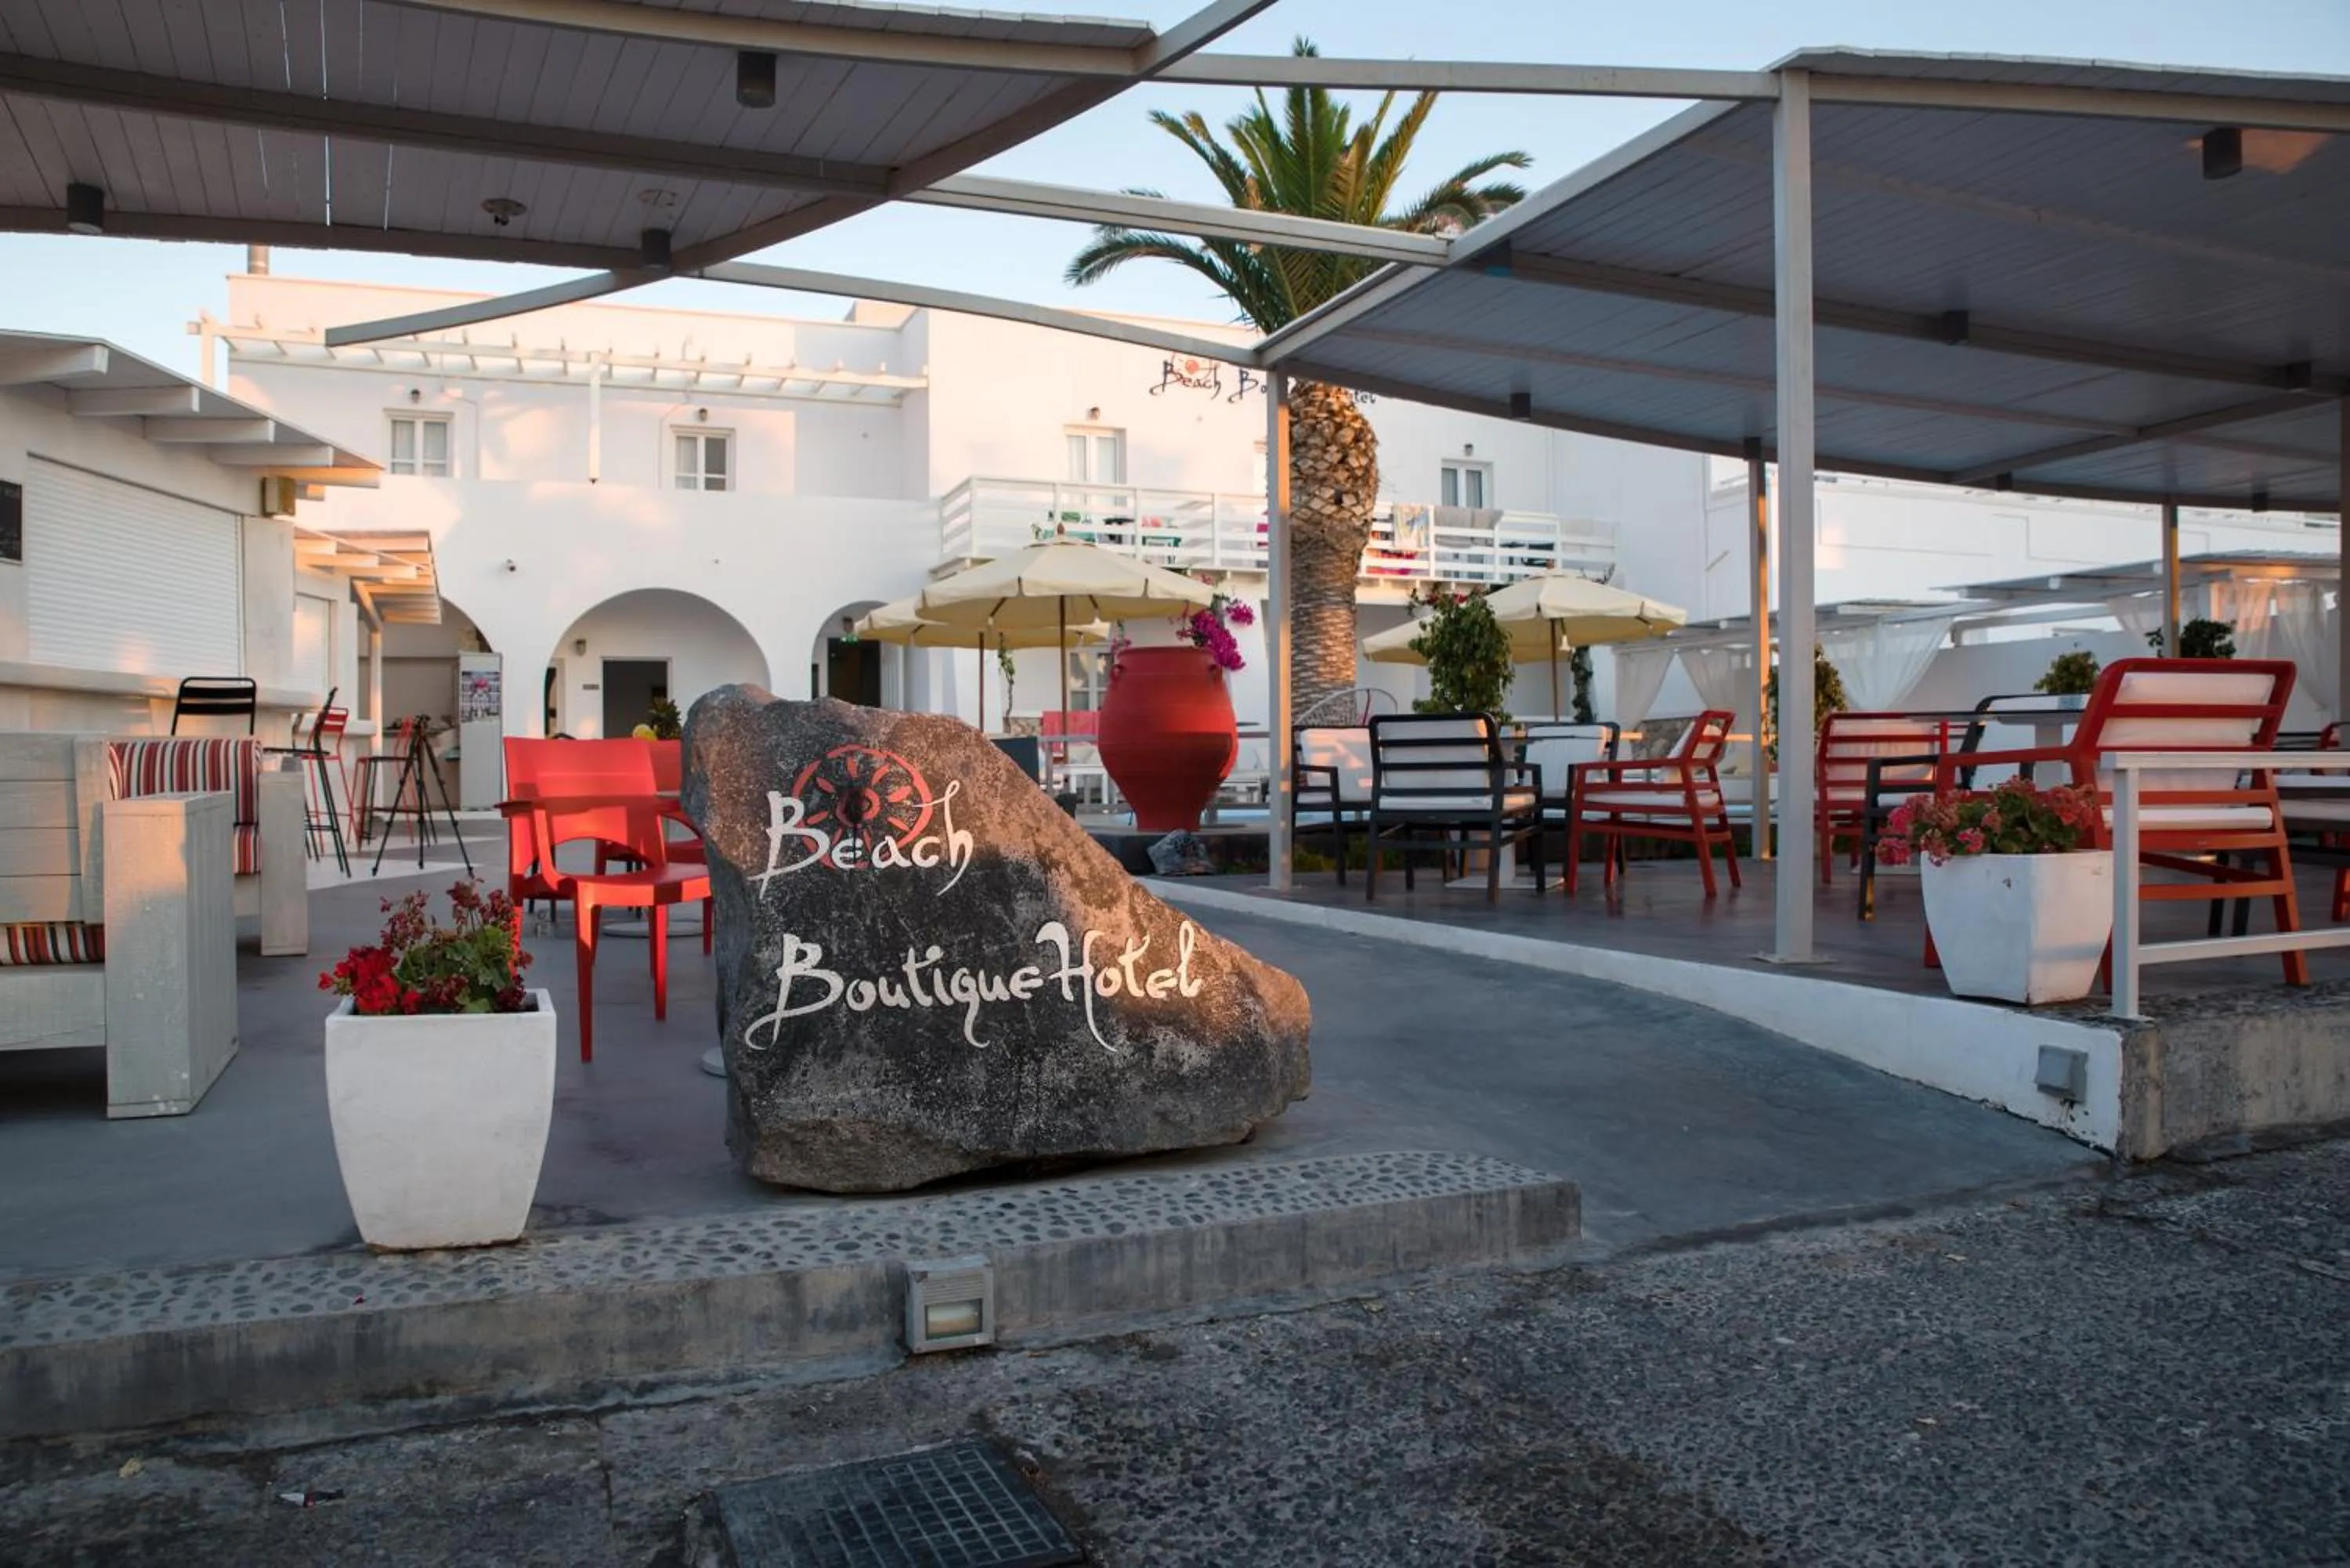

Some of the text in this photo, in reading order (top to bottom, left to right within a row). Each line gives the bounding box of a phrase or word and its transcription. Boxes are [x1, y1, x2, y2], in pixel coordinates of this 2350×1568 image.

[1149, 360, 1221, 399] Beach
[747, 780, 974, 899] Beach
[745, 921, 1202, 1052] Boutique Hotel
